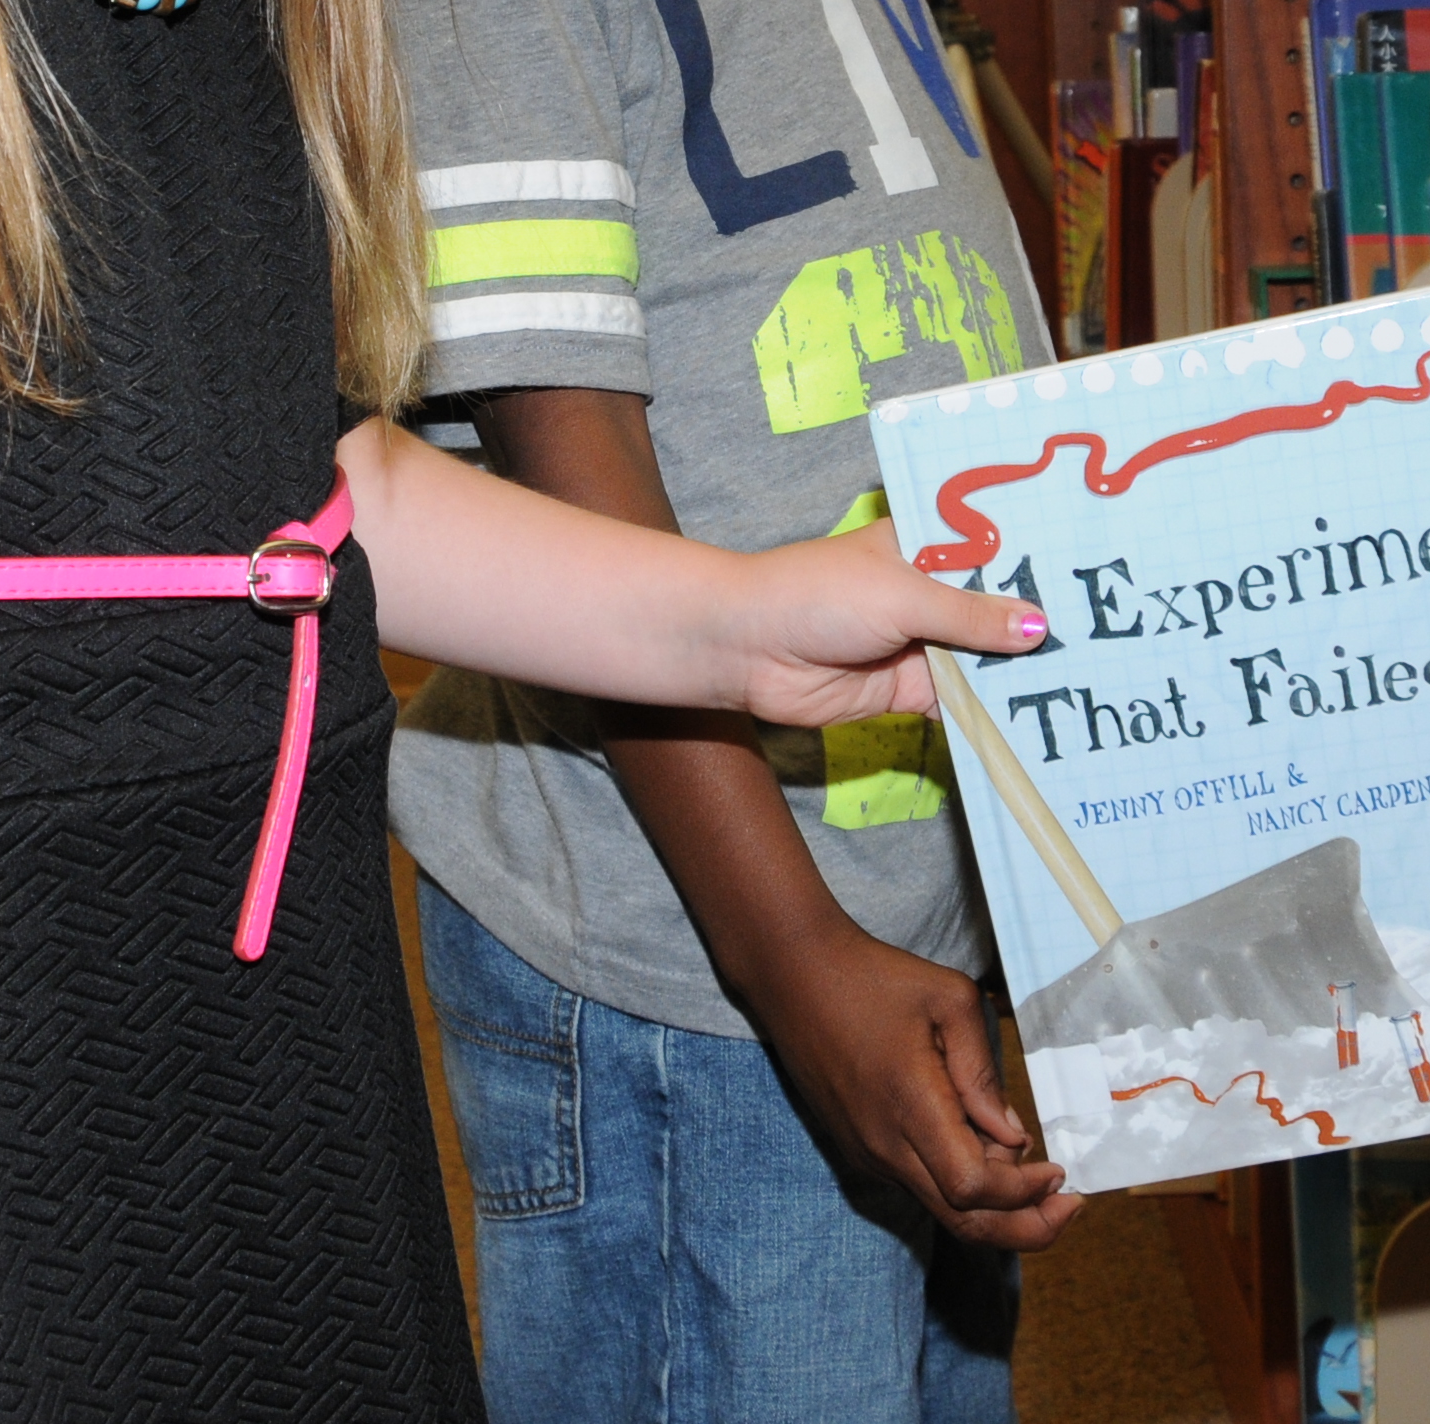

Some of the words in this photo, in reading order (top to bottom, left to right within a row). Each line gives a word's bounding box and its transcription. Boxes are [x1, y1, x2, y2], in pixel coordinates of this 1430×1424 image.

[1008, 676, 1206, 763] That
[1073, 789, 1166, 830] JENNY
[1173, 770, 1276, 813] OFFILL
[1287, 761, 1309, 788] &
[1247, 794, 1328, 837] NANCY
